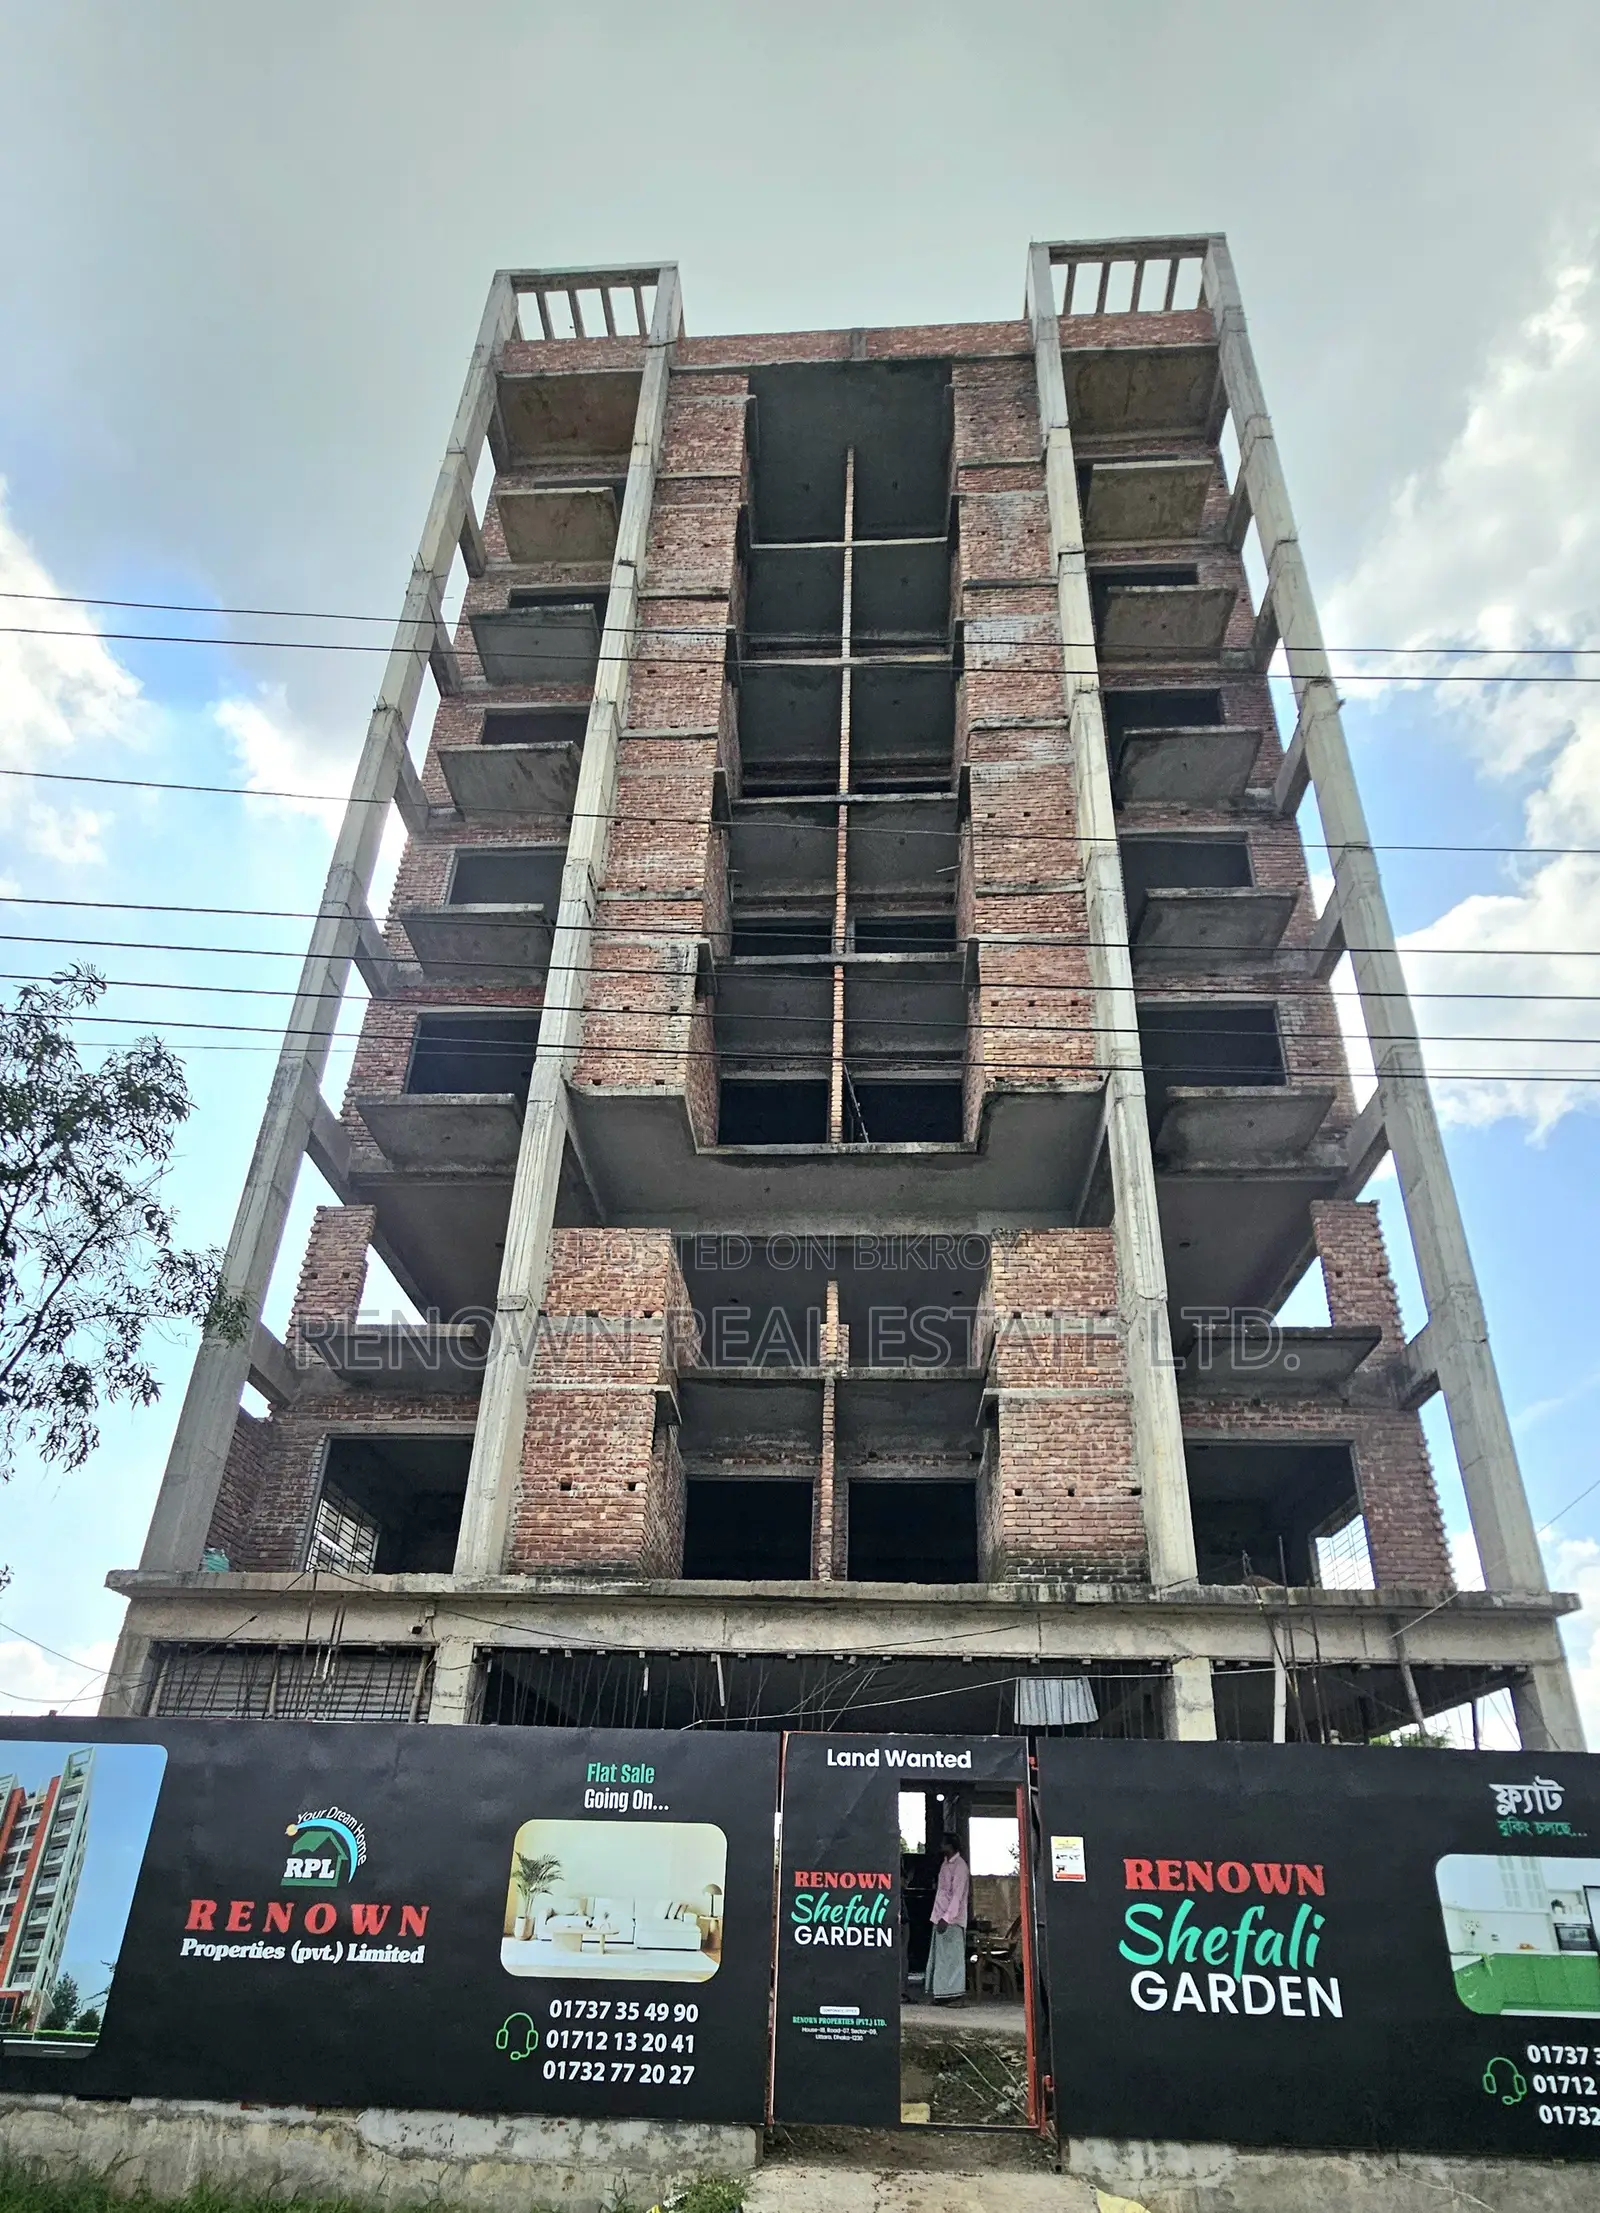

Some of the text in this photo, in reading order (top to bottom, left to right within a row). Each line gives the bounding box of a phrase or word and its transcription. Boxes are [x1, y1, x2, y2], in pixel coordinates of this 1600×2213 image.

[827, 1748, 972, 1769] Land Wanted
[587, 1762, 655, 1784] Flat Sale
[584, 1787, 670, 1813] Going On...
[326, 1806, 358, 1829] Dream
[353, 1823, 367, 1866] Home
[283, 1857, 336, 1879] RPL
[794, 1871, 893, 1890] RENOWN
[1122, 1858, 1326, 1896] RENOWN
[184, 1899, 430, 1937] RENOWN
[790, 1892, 890, 1931] Shefali
[794, 1925, 893, 1948] GARDEN
[1118, 1898, 1326, 1984] Shefali
[180, 1938, 426, 1964] Properties (pvt.) Limited
[1130, 1970, 1344, 2018] GARDEN
[549, 1999, 699, 2023] 01737 35 49 90
[546, 2029, 695, 2054] 01712 13 20 41
[1526, 2044, 1589, 2066] 01737
[542, 2060, 695, 2085] 01732 77 20 27
[1532, 2074, 1598, 2096] 01712
[1538, 2104, 1600, 2126] 01732
